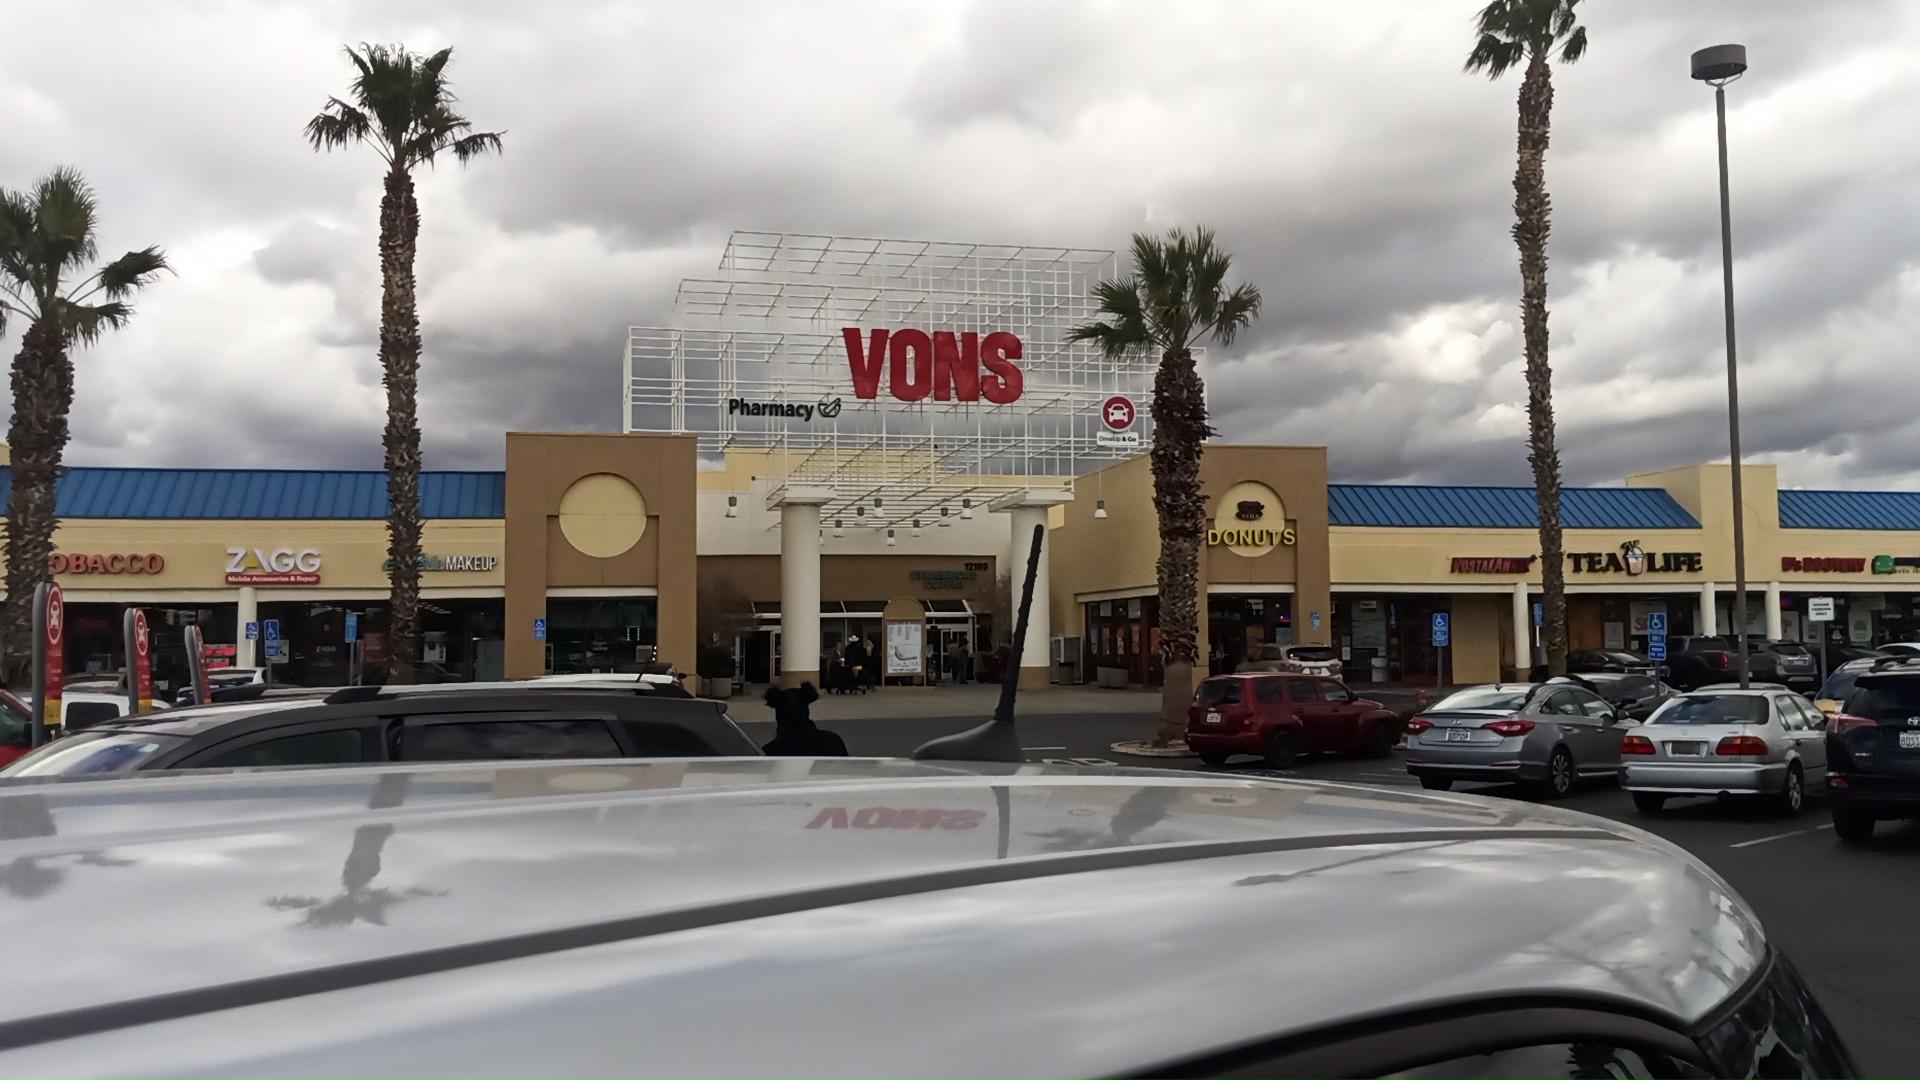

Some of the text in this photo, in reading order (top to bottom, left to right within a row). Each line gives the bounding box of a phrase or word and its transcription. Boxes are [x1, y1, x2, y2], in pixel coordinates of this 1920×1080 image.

[842, 327, 1024, 404] VONS
[729, 398, 814, 422] Pharmacy
[1207, 529, 1296, 546] DONUTS
[48, 553, 164, 574] OBACCO
[225, 548, 321, 573] ZAGG
[445, 555, 497, 571] MAKEUP
[1567, 552, 1703, 573] TEA LIFE
